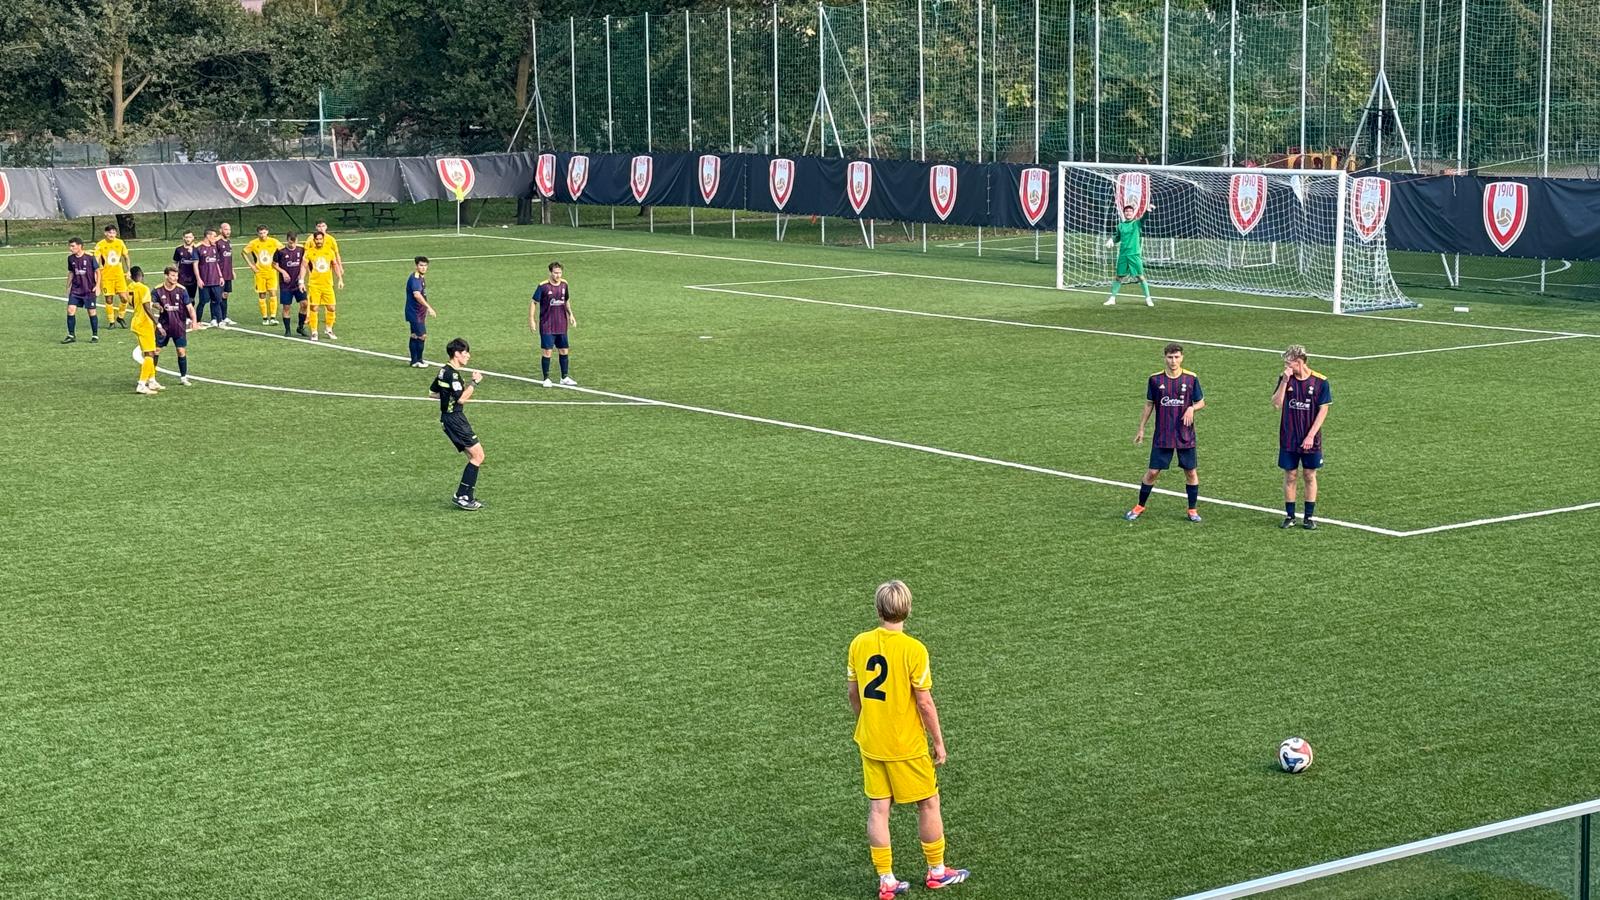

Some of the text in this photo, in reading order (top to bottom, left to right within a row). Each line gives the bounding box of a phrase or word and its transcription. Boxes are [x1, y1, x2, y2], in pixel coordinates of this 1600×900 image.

[1030, 170, 1041, 181] 1910
[1241, 174, 1256, 186] 1910
[1498, 183, 1515, 197] 1910
[863, 654, 888, 702] 2
